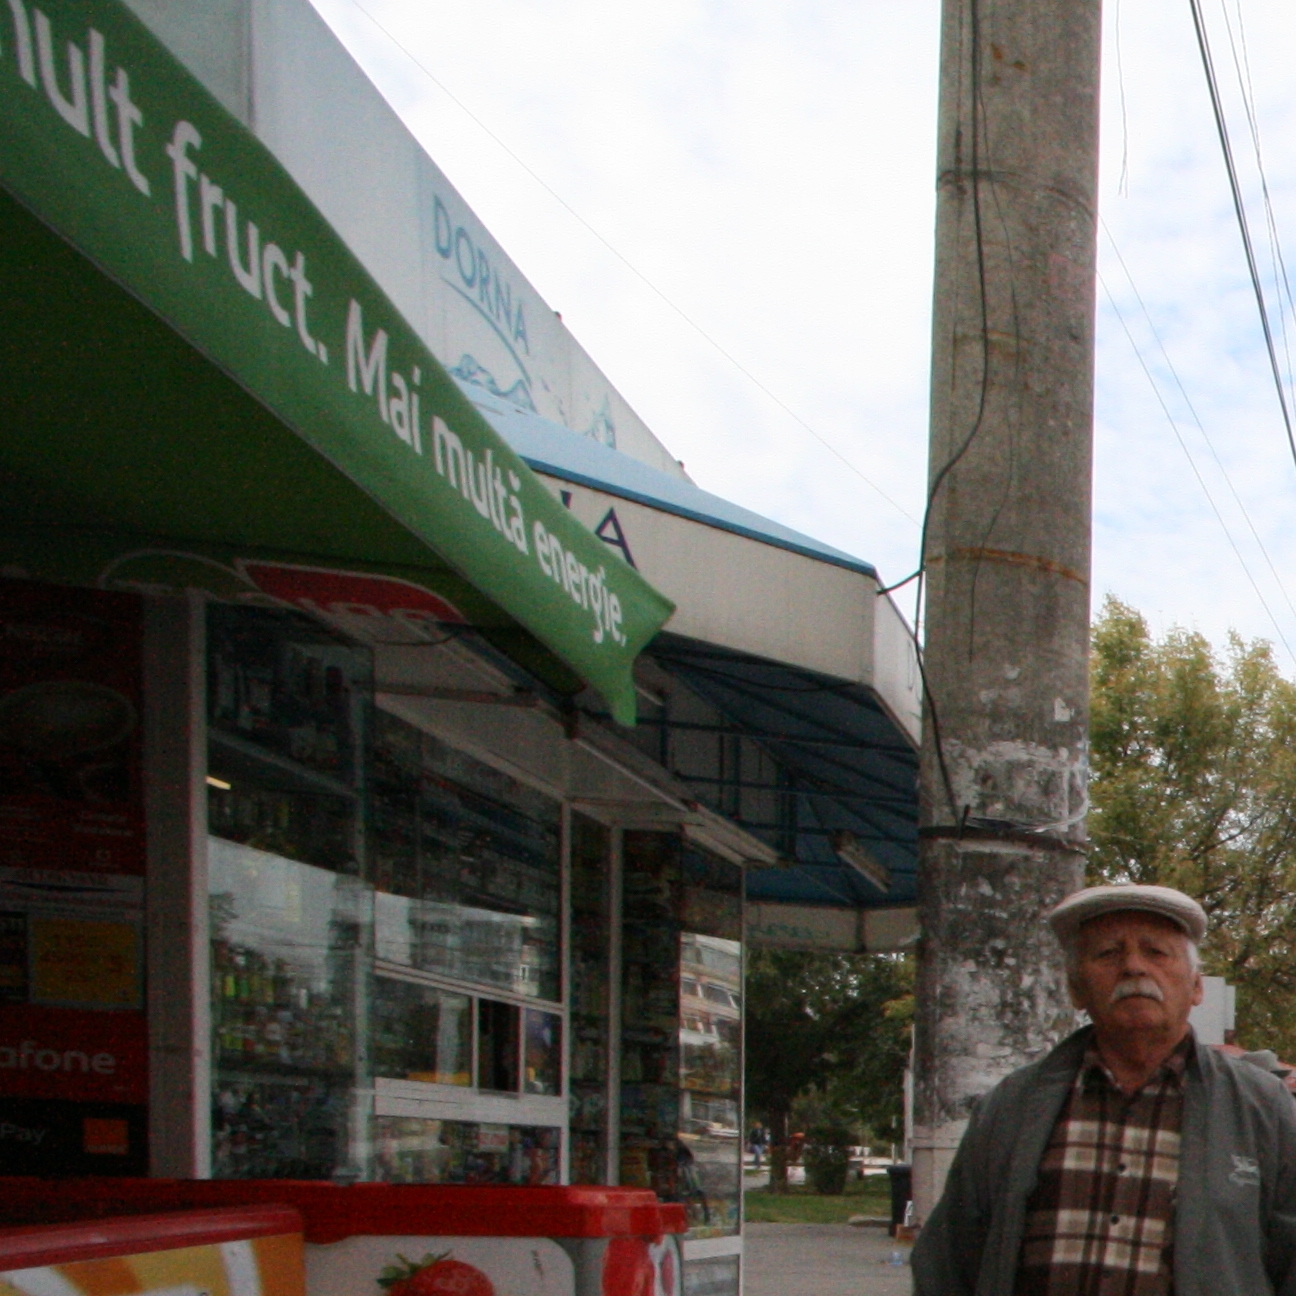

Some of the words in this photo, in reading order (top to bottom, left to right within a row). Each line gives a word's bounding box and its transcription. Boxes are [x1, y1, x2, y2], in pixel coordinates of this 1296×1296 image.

[165, 119, 329, 366] fruct.
[345, 298, 423, 456] Mai
[432, 192, 530, 357] DORNA
